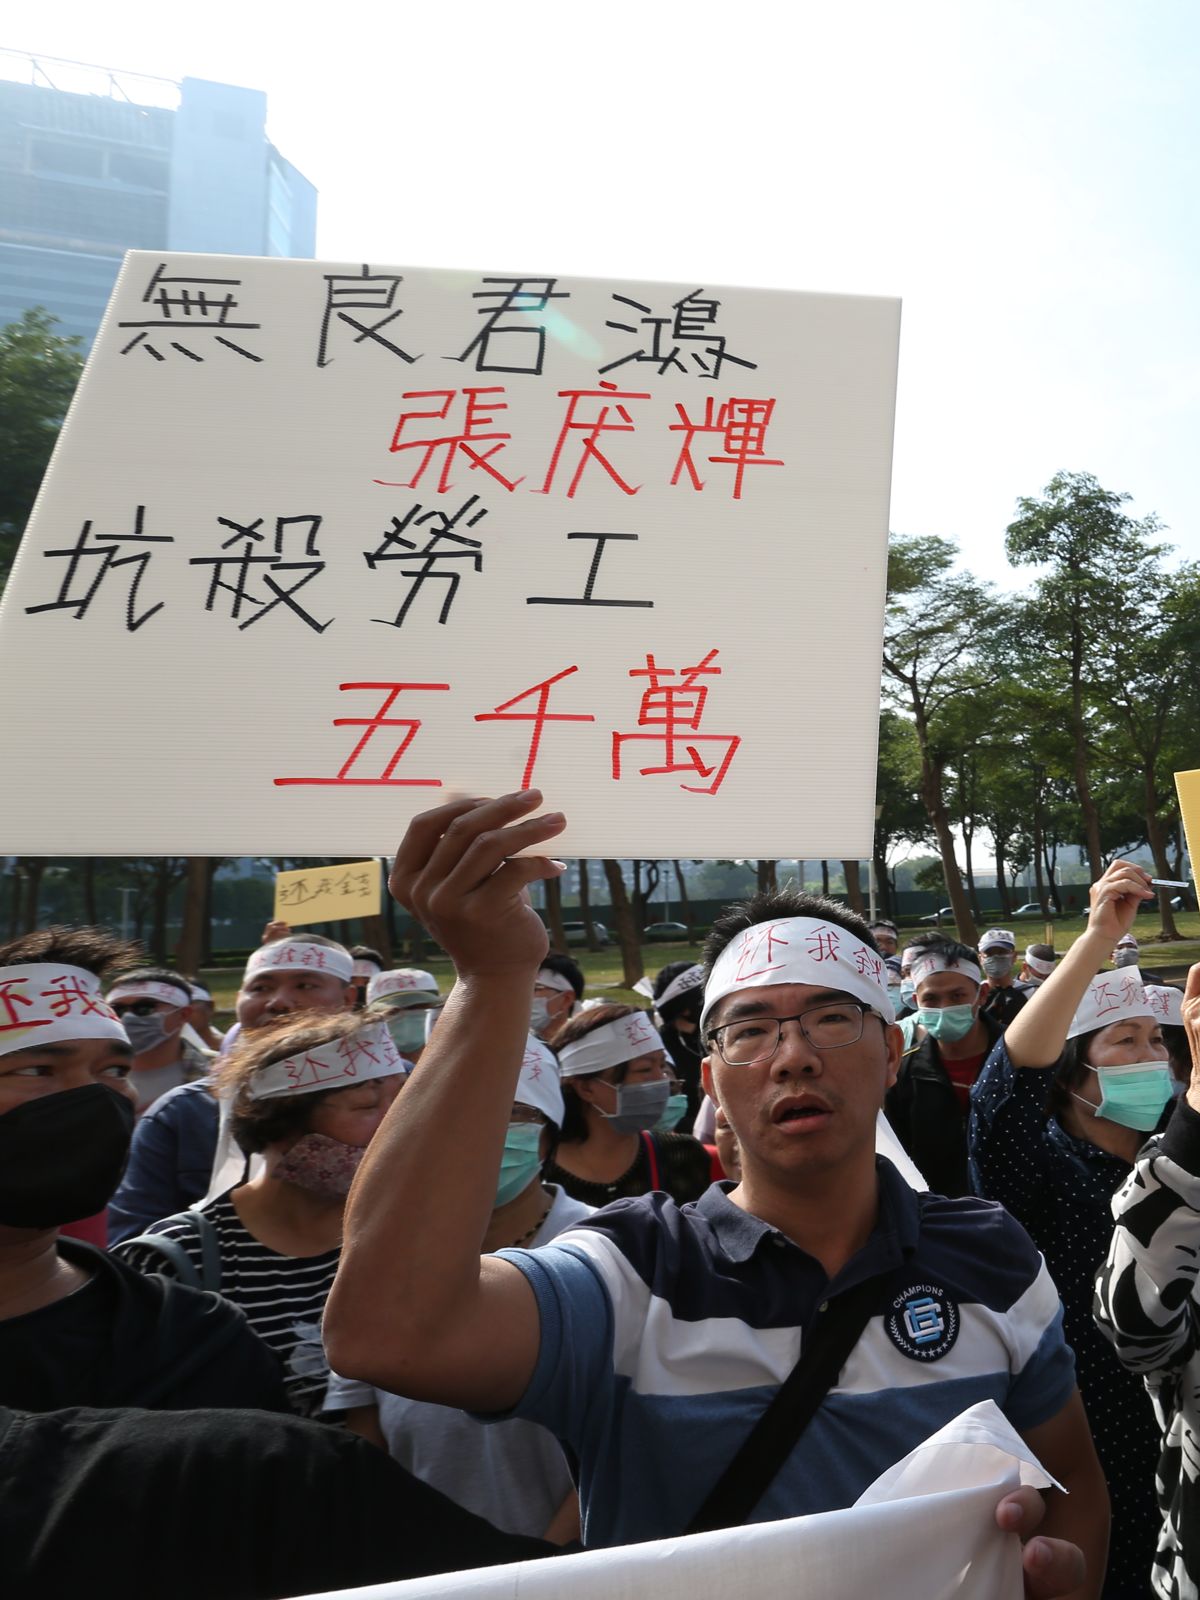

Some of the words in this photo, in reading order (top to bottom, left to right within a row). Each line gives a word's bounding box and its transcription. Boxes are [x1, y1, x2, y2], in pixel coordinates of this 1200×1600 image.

[117, 263, 759, 379] 無良君鴻
[25, 494, 655, 634] 坑殺勞工
[273, 649, 742, 795] 五千萬
[892, 1284, 945, 1309] CHAMPIONS
